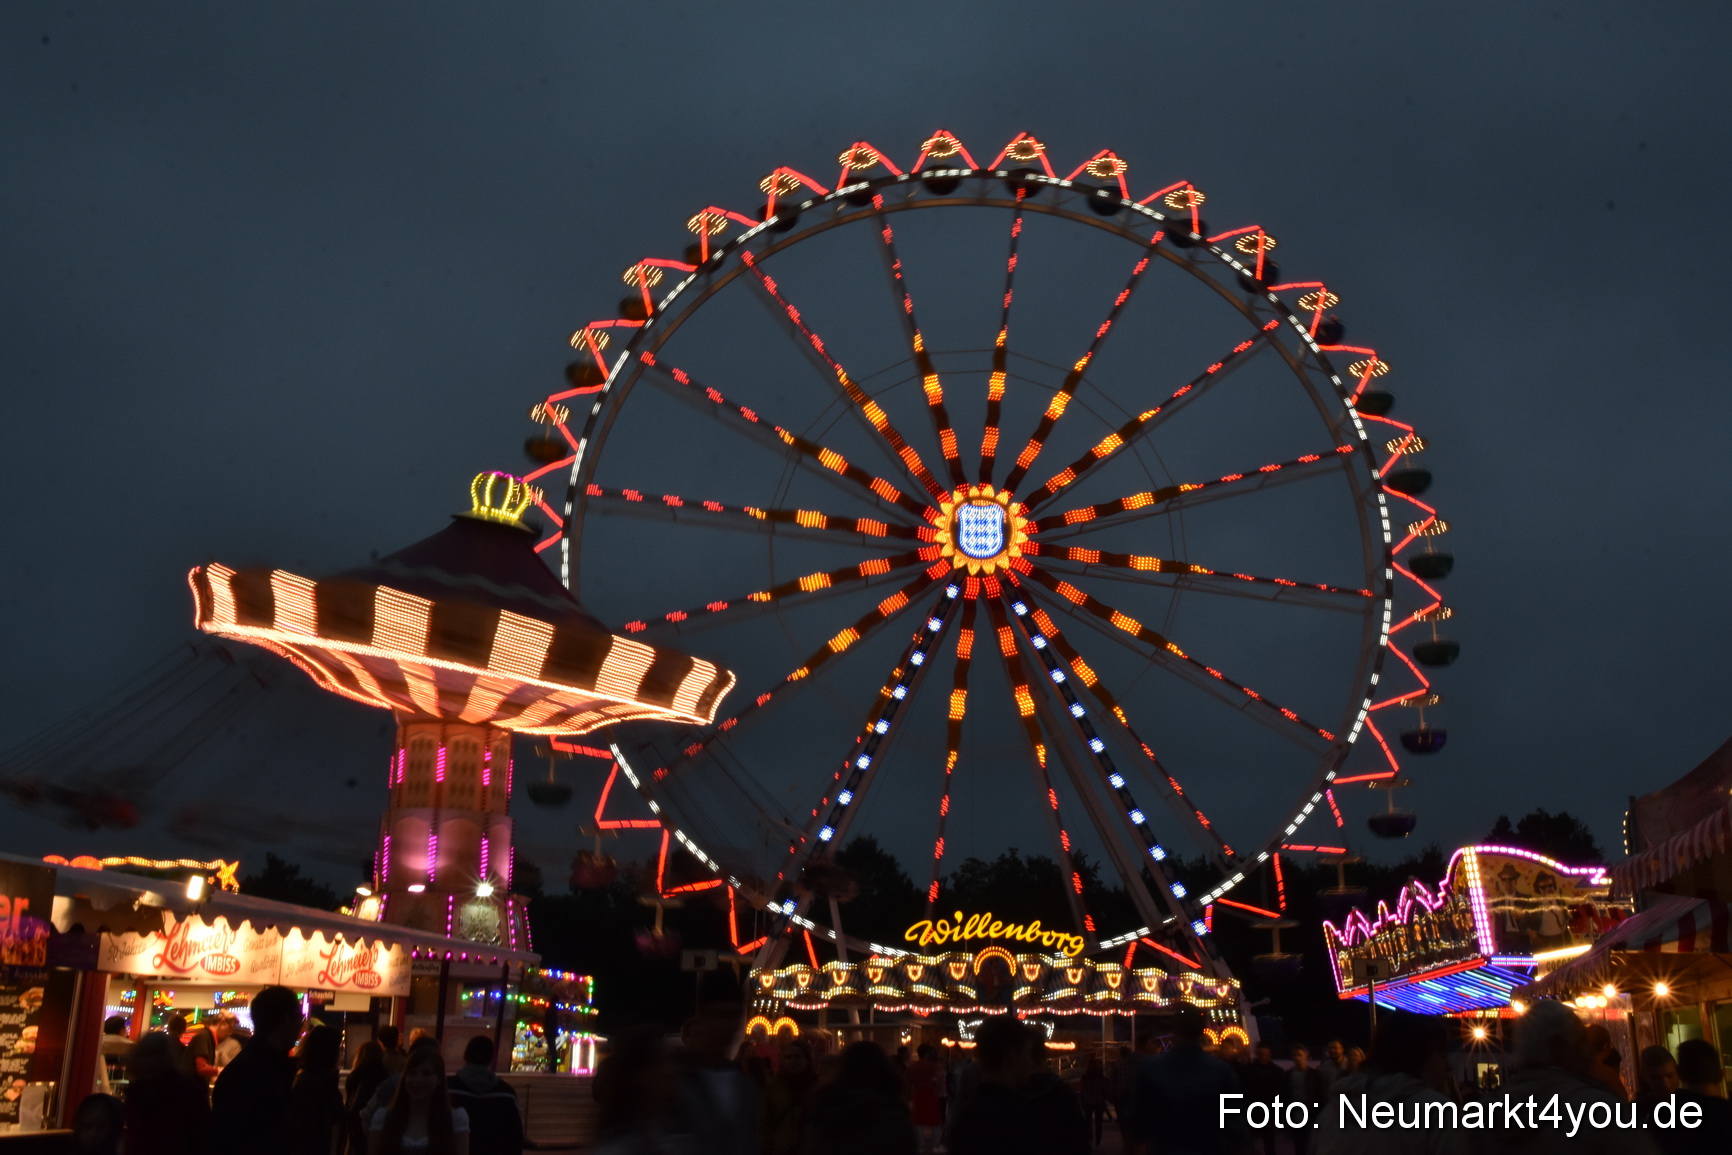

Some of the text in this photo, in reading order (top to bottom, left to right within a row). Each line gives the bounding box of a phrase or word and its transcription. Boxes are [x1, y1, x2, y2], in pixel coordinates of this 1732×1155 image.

[904, 910, 1085, 957] Willenborg
[204, 955, 234, 972] IMBISS
[354, 972, 379, 987] IMBISS
